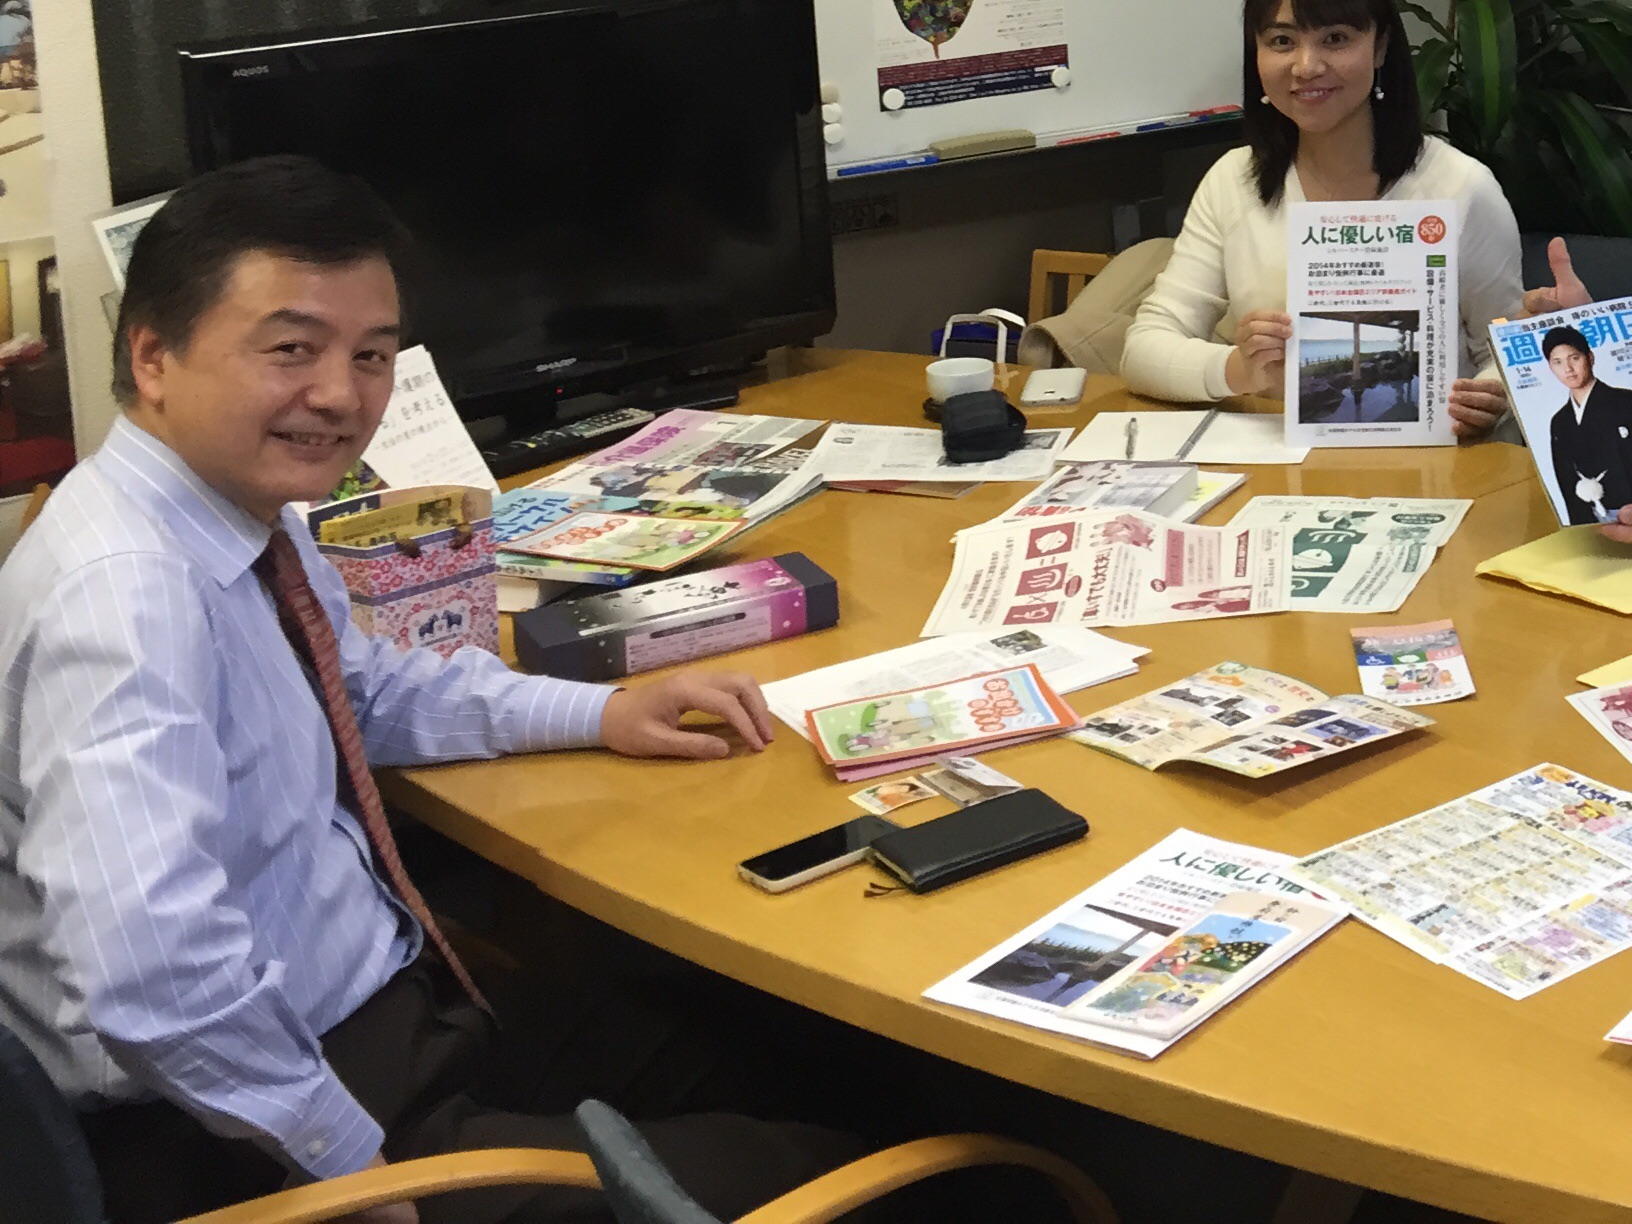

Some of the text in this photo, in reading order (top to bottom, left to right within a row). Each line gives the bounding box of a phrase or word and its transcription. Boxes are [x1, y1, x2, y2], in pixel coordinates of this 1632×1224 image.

[1301, 224, 1415, 245] 人に優しい宿
[1420, 224, 1443, 236] 850
[535, 357, 577, 373] SHARP
